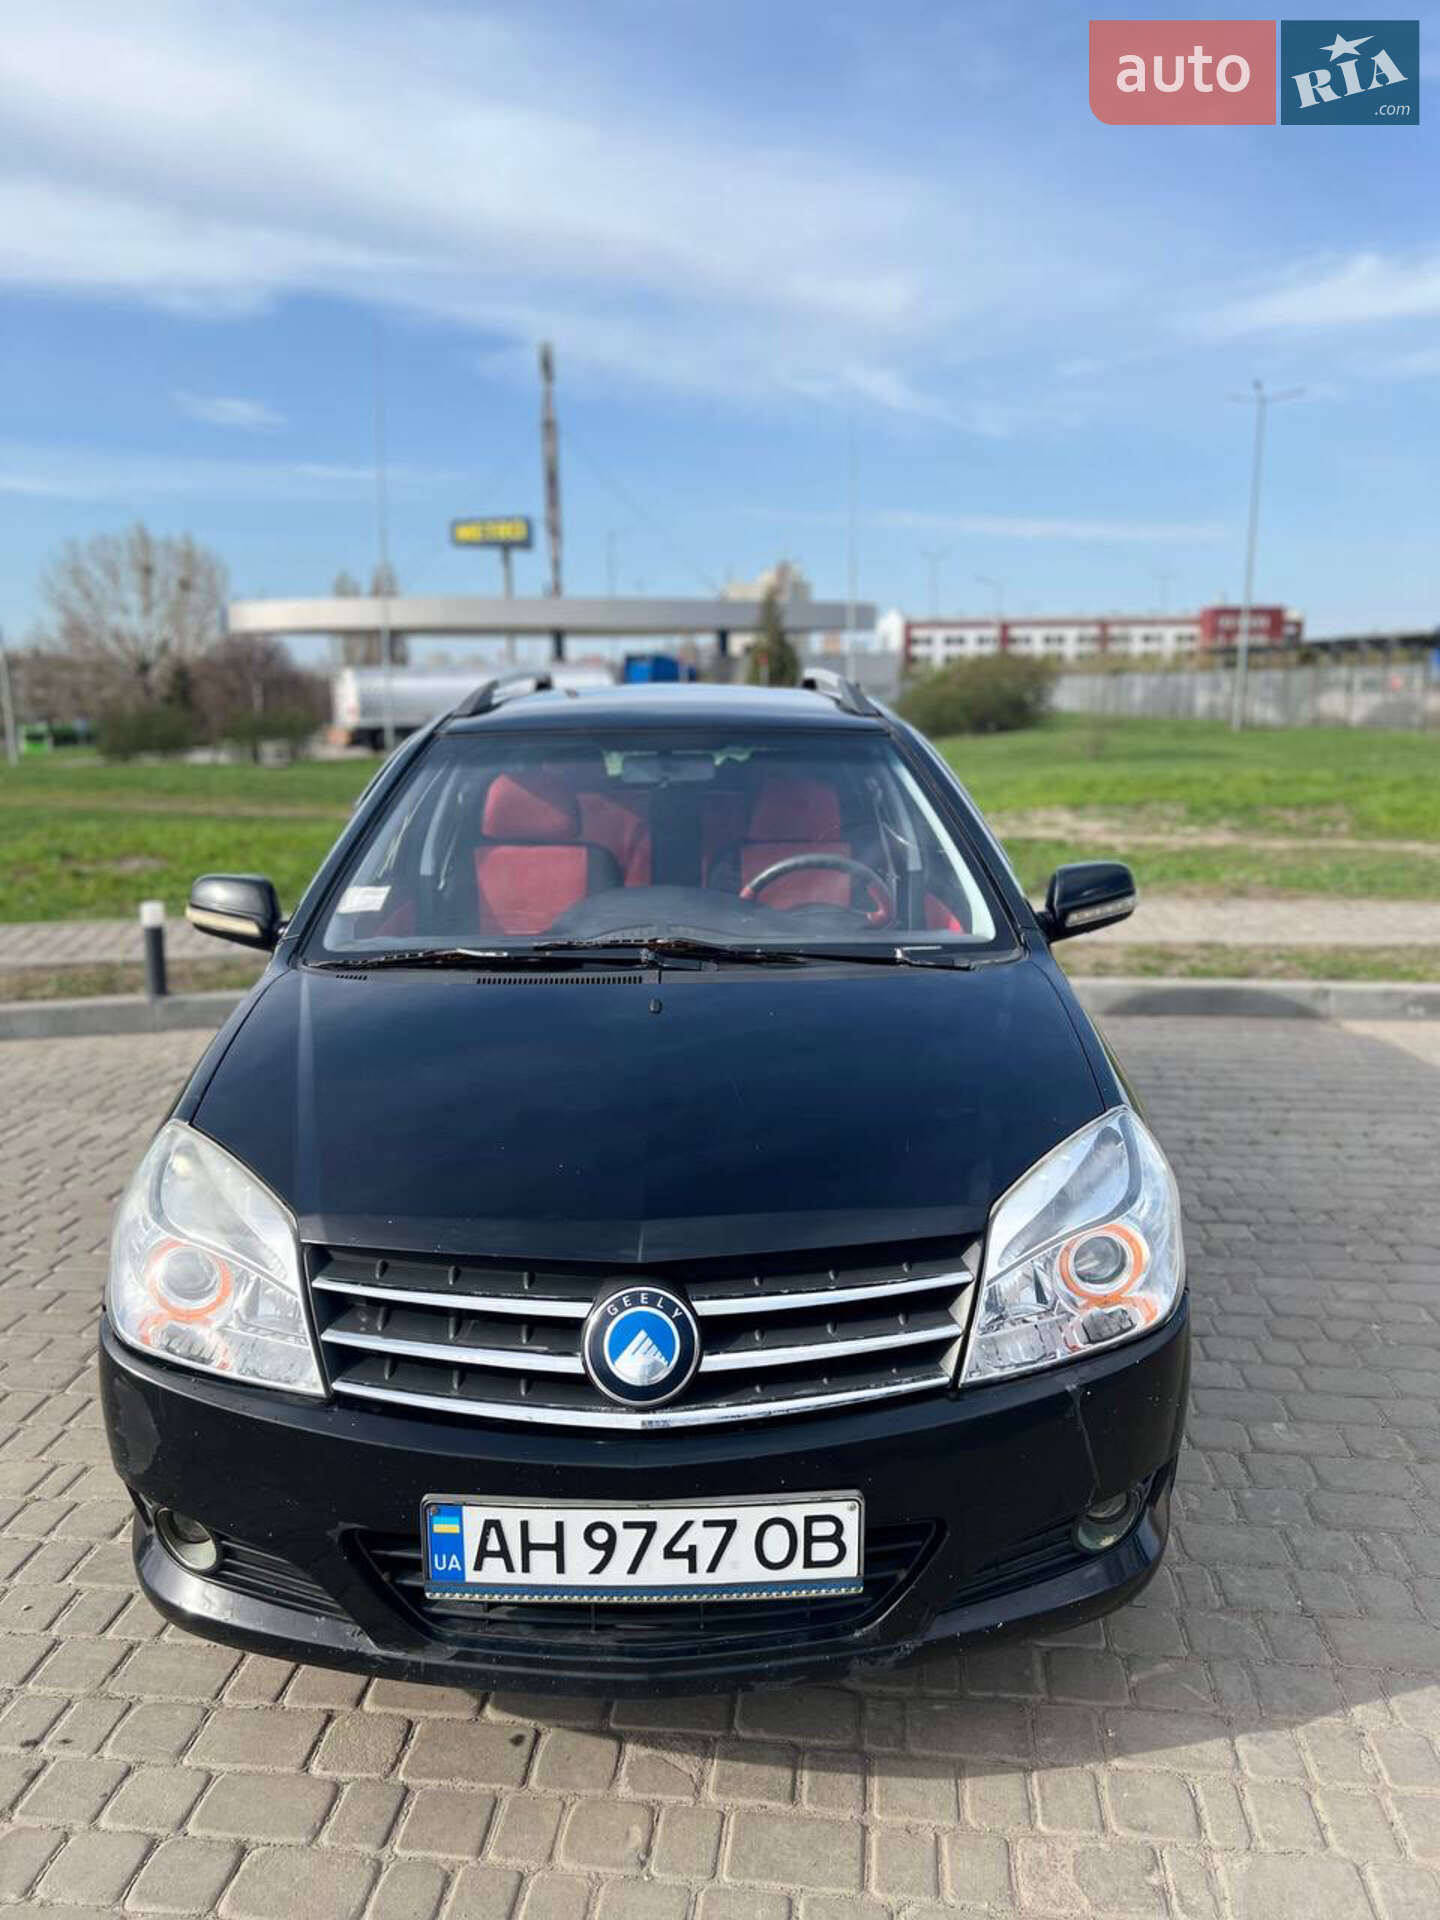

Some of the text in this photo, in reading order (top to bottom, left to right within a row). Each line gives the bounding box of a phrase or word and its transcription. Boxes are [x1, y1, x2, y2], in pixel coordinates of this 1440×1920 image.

[607, 1293, 682, 1319] GEELY
[473, 1514, 848, 1575] AH 9747 OB
[434, 1554, 462, 1572] UA
